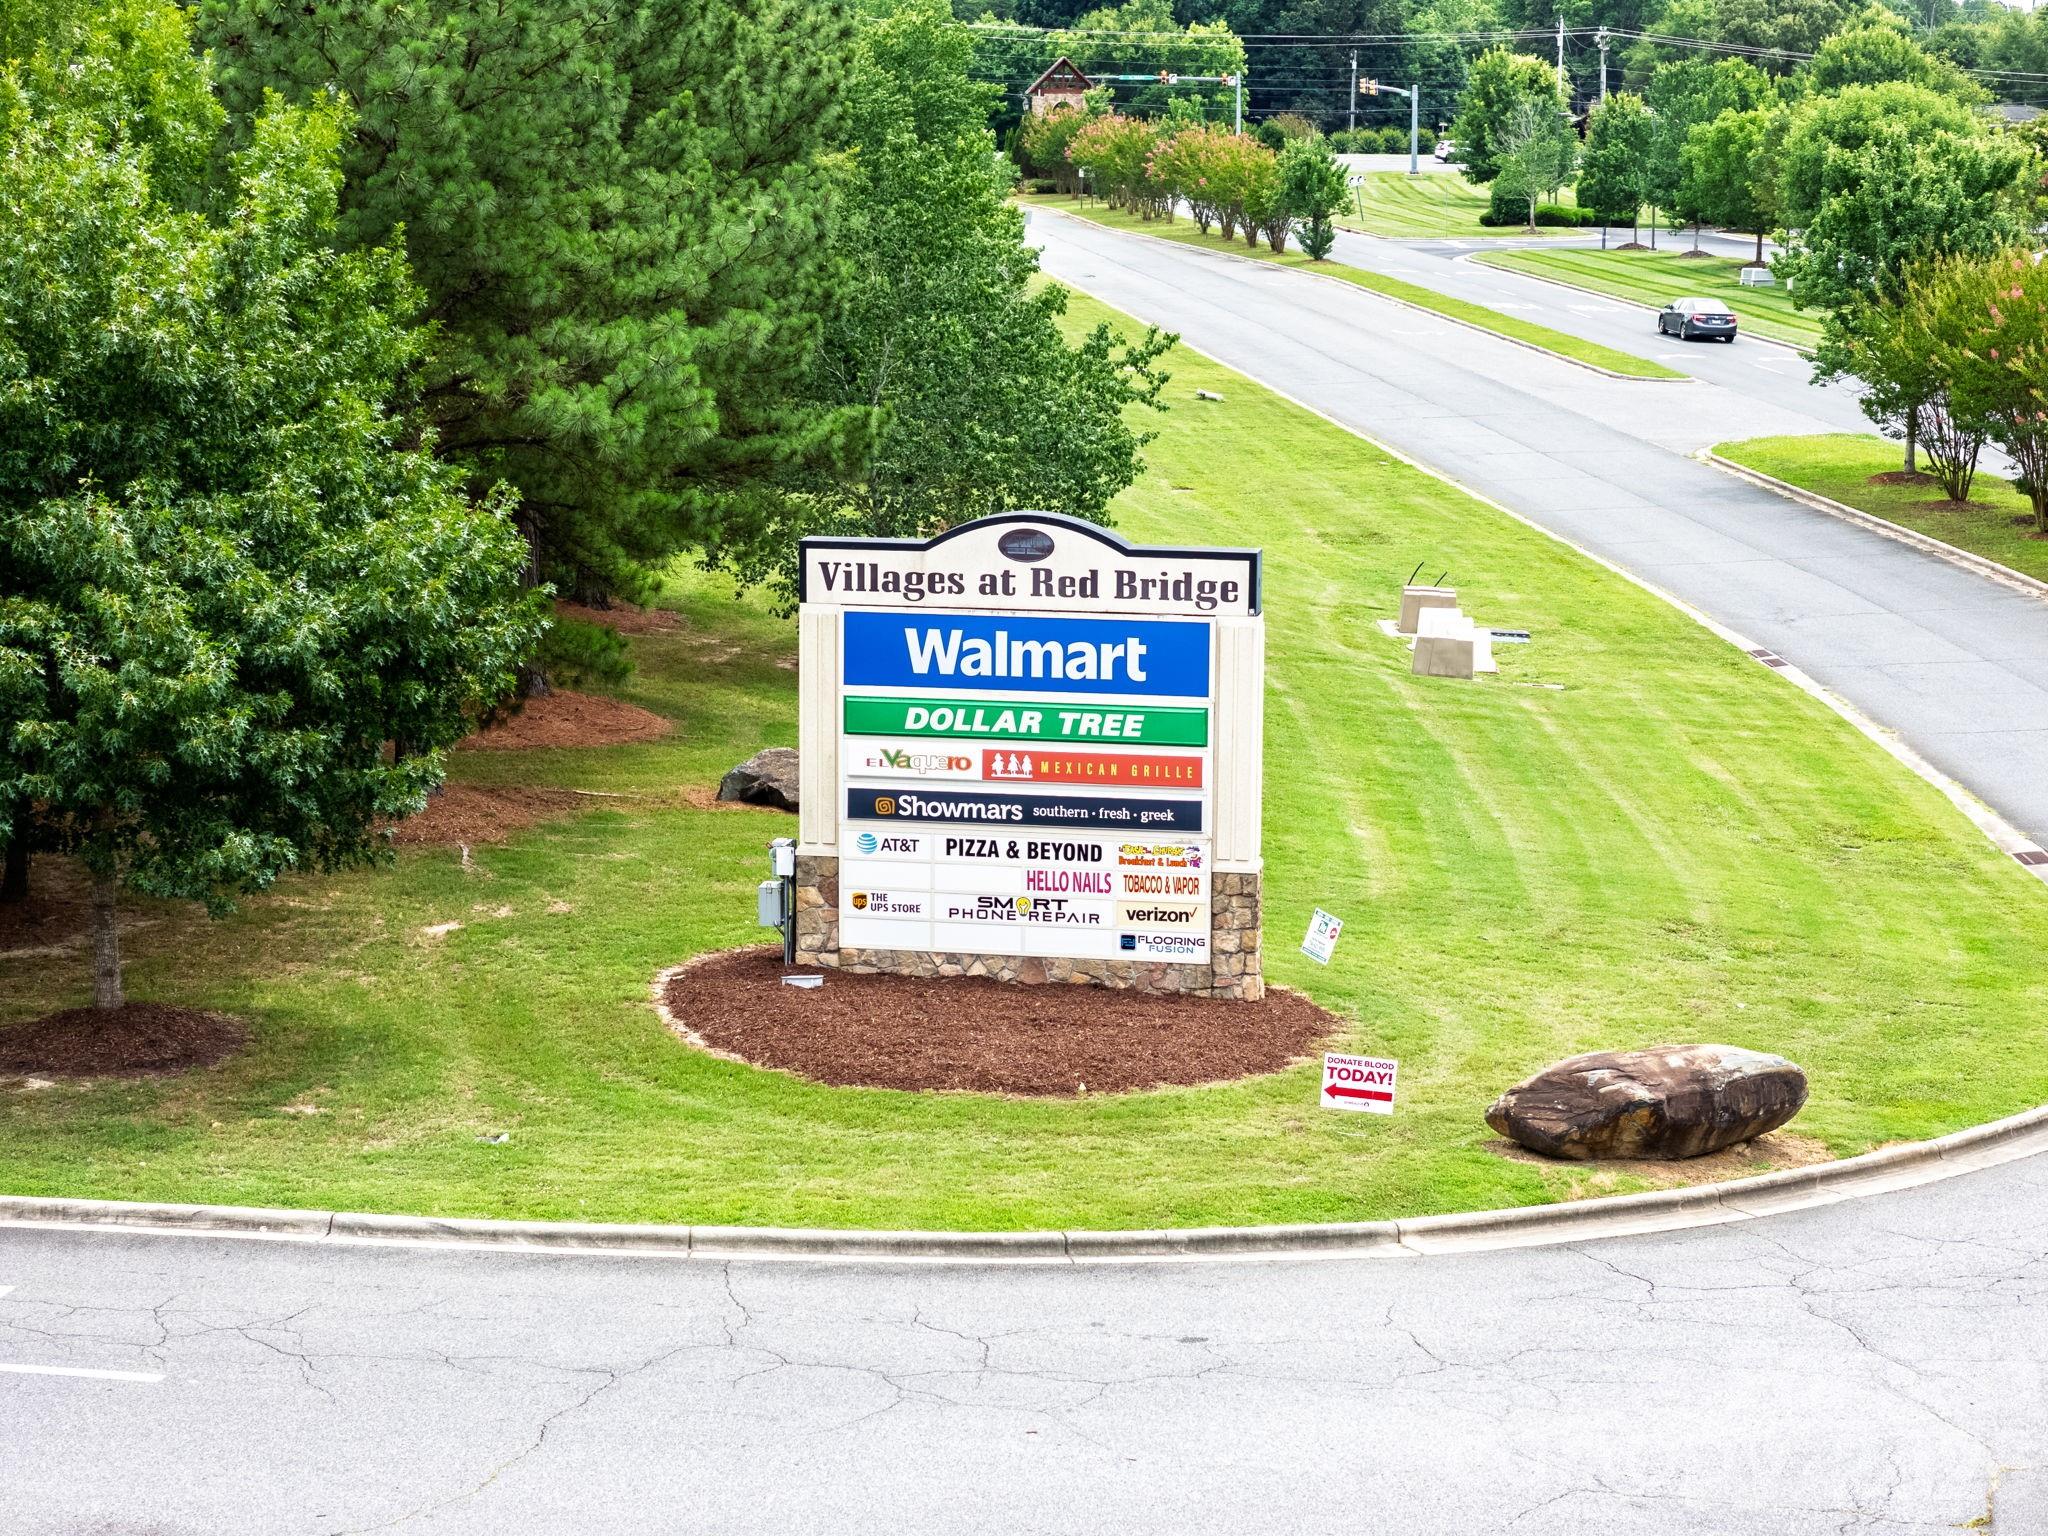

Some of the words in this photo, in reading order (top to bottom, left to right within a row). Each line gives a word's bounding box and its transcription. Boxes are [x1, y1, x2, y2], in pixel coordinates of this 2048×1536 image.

[818, 562, 965, 601] Villages
[978, 570, 1016, 596] at
[1030, 567, 1099, 598] Red
[1114, 570, 1239, 610] Bridge
[904, 627, 1147, 682] Walmart
[904, 707, 1043, 734] DOLLAR
[1058, 711, 1145, 737] TREE
[880, 749, 972, 774] Vaquero
[1040, 761, 1118, 776] MEXICAN
[1131, 764, 1193, 778] GRILLE
[898, 795, 1023, 821] Showmars
[1033, 805, 1088, 819] southern
[1099, 807, 1130, 820] fresh
[1140, 809, 1175, 823] greek
[881, 838, 920, 852] AT&T
[946, 838, 999, 858] PIZZA
[1006, 840, 1020, 859] &
[1027, 841, 1103, 862] BEYOND
[1027, 870, 1069, 892] HELLO
[1073, 872, 1112, 894] NAILS
[1123, 875, 1162, 894] TOBACCO
[1165, 876, 1170, 894] &
[1173, 876, 1200, 895] VAPOR
[852, 898, 868, 908] ups
[871, 893, 888, 901] THE
[978, 896, 1068, 911] SMRT
[871, 903, 888, 912] UPS
[891, 903, 920, 913] STORE
[949, 908, 1016, 920] PHONE
[1029, 911, 1100, 923] REPAIR
[1126, 907, 1189, 922] verizon
[1138, 935, 1205, 947] FLOORING
[1149, 944, 1194, 954] FUSION
[1327, 1056, 1362, 1067] DONATE
[1364, 1060, 1394, 1070] BLOOD
[1327, 1066, 1393, 1085] TODAY!
